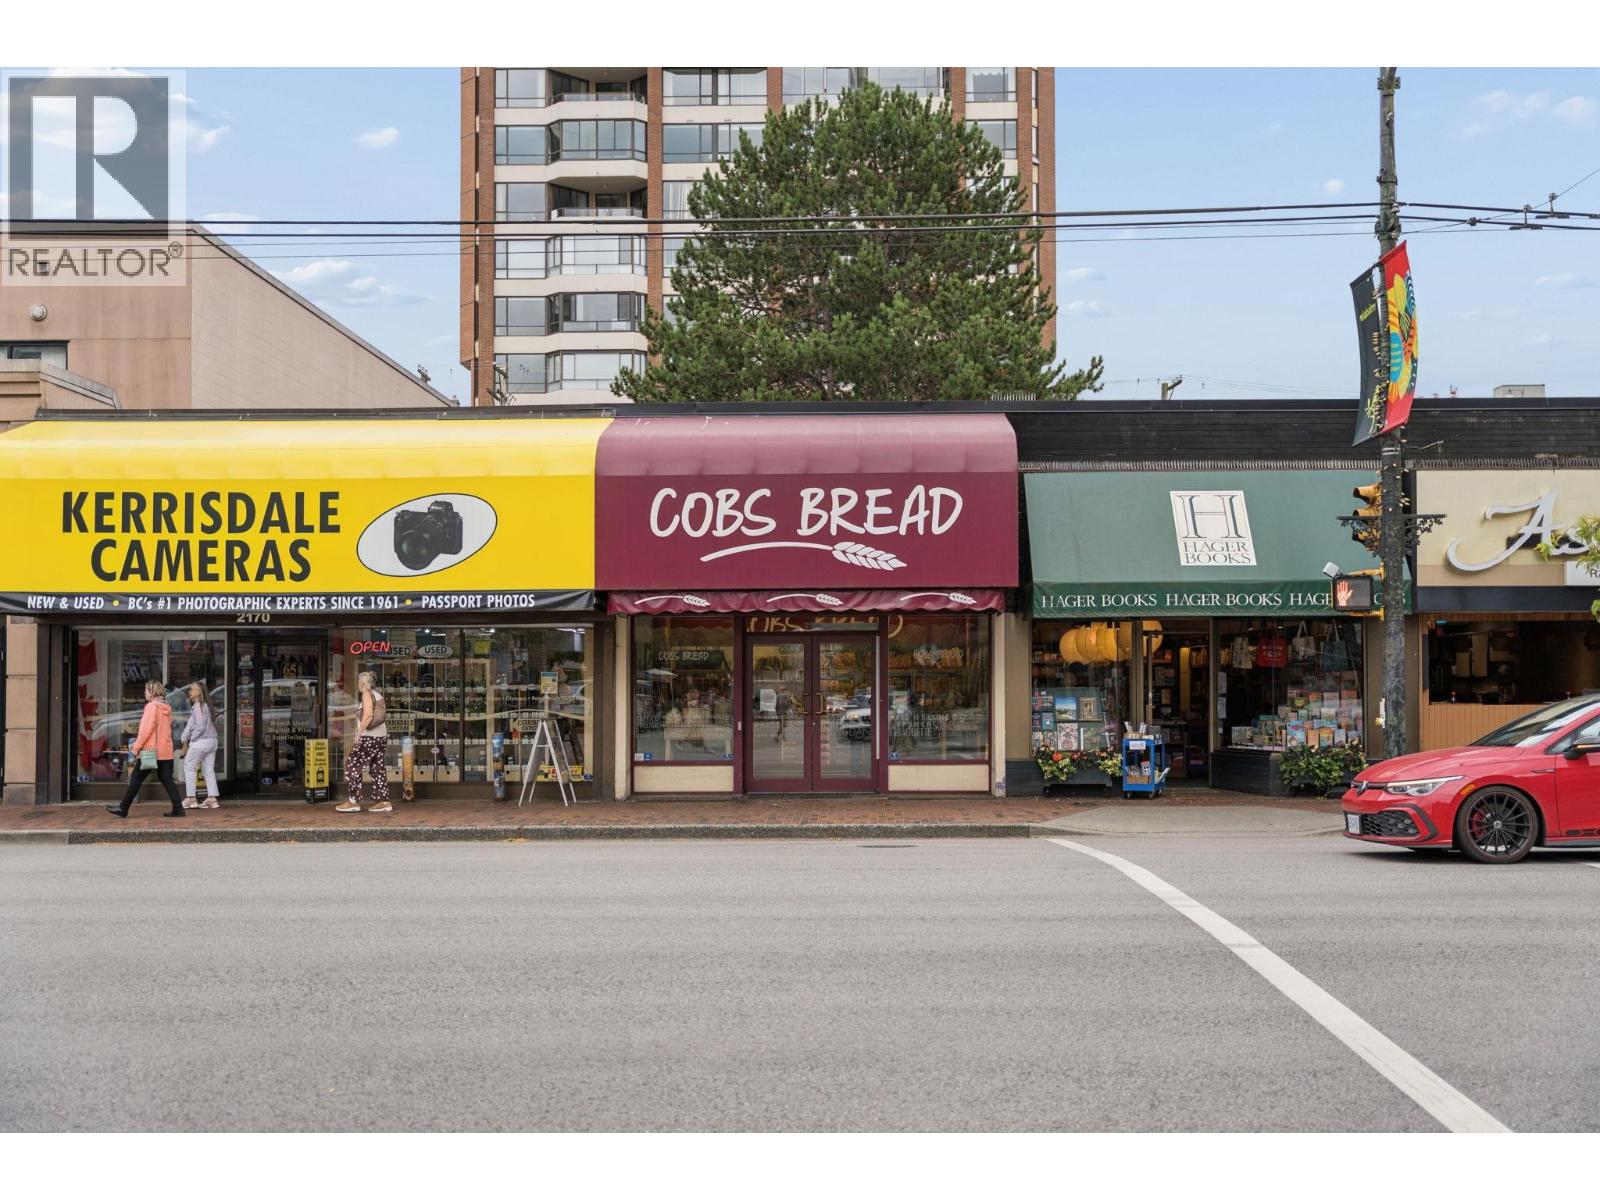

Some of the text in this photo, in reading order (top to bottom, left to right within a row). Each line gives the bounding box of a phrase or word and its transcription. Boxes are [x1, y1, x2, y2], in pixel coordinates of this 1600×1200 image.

[62, 491, 341, 534] KERRISDALE
[649, 484, 963, 537] COBS BREAD
[1183, 541, 1248, 552] HAGER
[91, 538, 311, 582] CAMERAS
[1185, 552, 1251, 564] BOOKS
[27, 594, 535, 610] NEW & USED BC's #1 PHOTOGRAPHIC EXPERTS SINCE 1961 PASSPORT PHOTOS
[1042, 593, 1333, 608] HAGER BOOKS HAGER BOOKS HAGE
[236, 613, 270, 623] 2170
[350, 641, 391, 654] OPEN
[424, 646, 447, 654] USED
